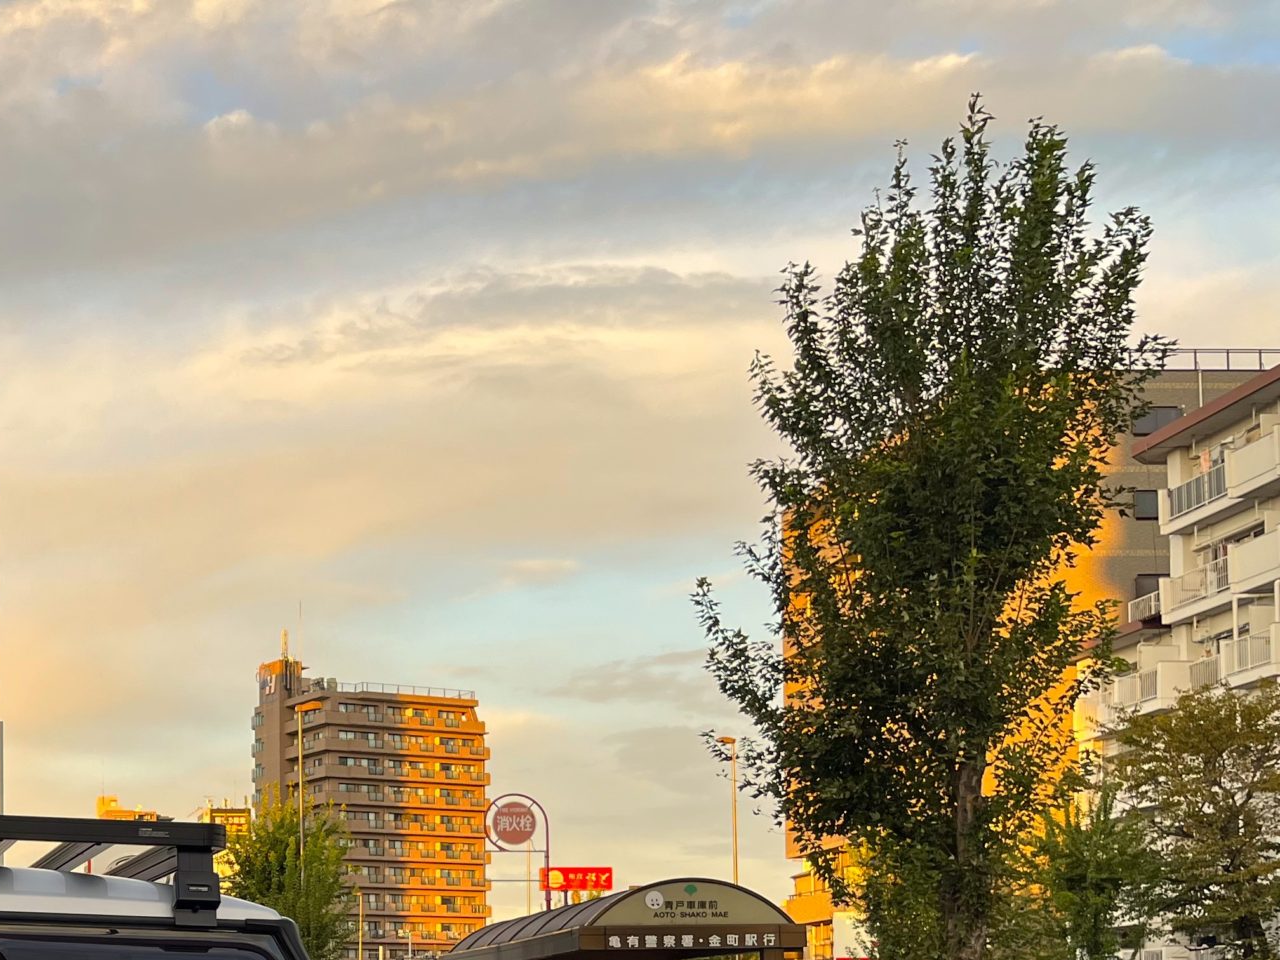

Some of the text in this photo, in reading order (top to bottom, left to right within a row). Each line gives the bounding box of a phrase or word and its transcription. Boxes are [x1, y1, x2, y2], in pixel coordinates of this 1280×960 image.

[496, 814, 533, 832] 消火栓
[664, 900, 718, 910] 青戸車庫前
[608, 933, 776, 948] 亀有警察署・金町駅行
